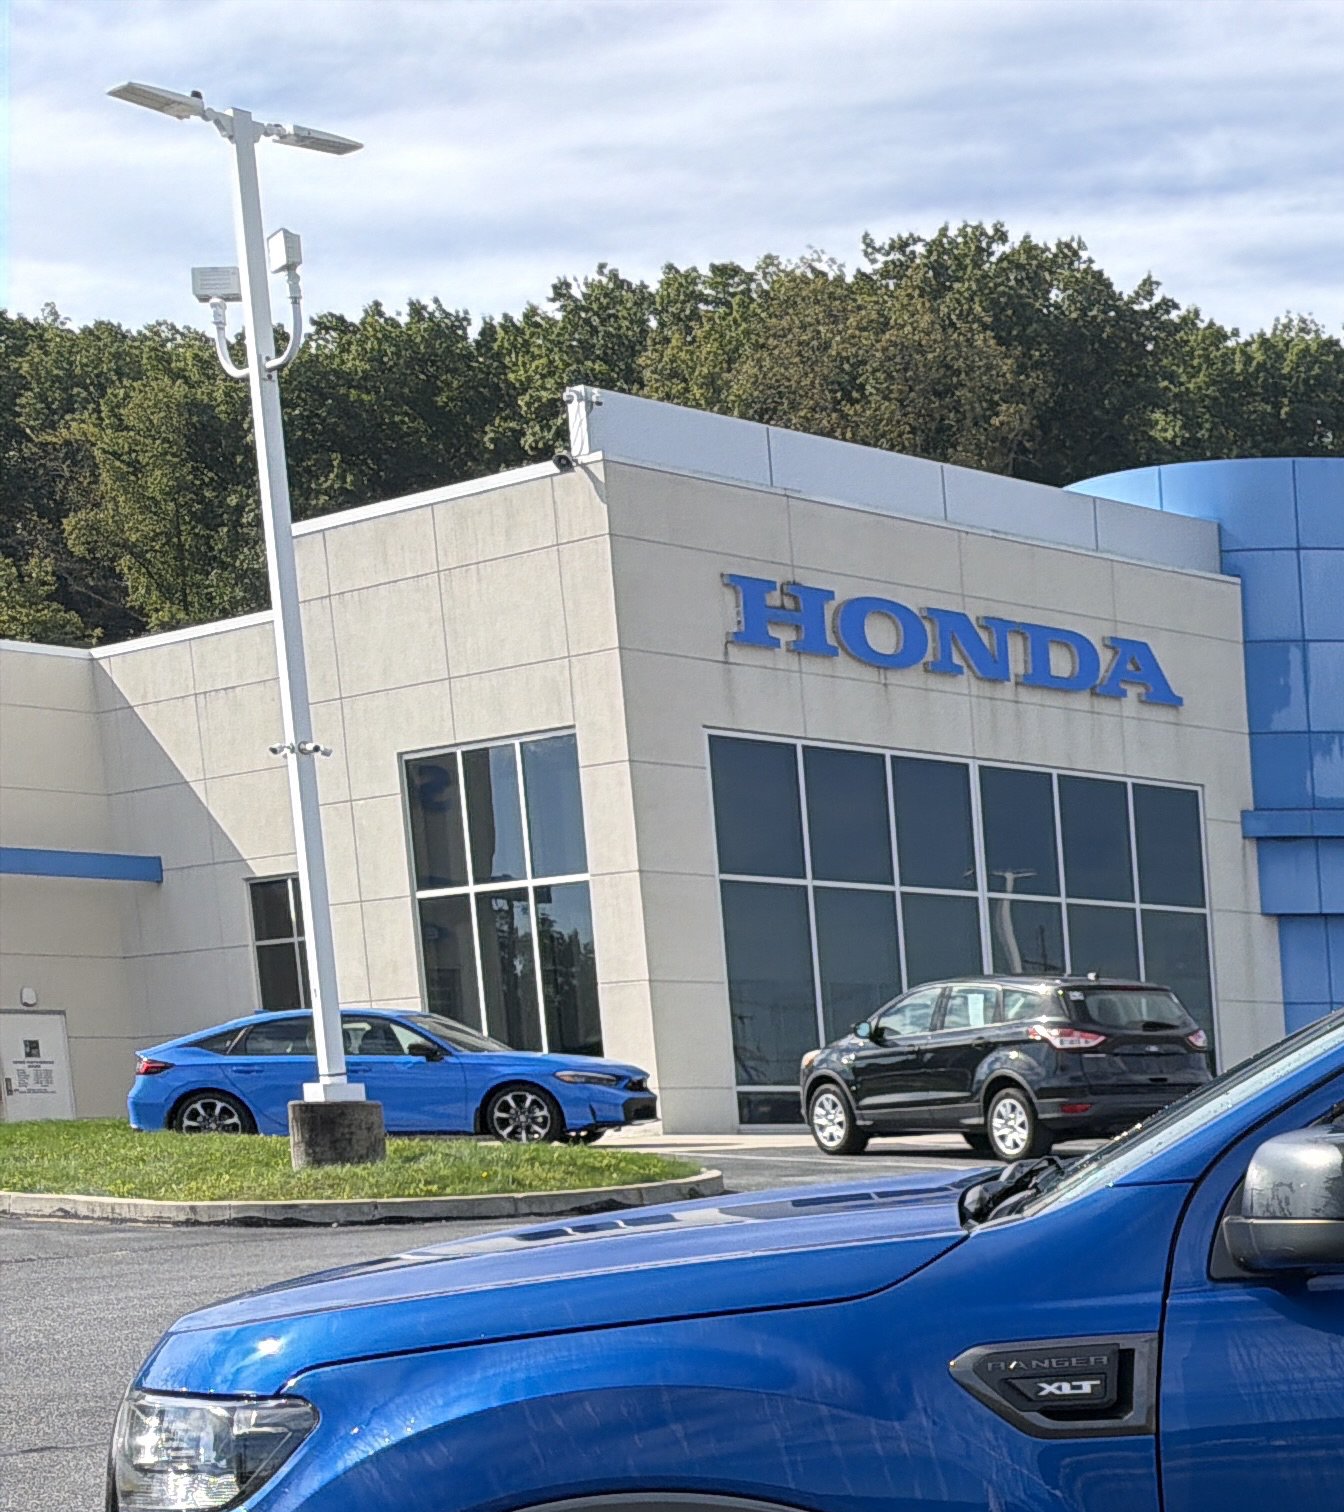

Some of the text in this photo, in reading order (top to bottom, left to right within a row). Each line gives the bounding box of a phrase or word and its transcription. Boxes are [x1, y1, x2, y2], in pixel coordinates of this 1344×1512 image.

[721, 573, 1184, 707] HONDA
[986, 1355, 1110, 1373] RANGER
[1036, 1380, 1101, 1396] XLT
